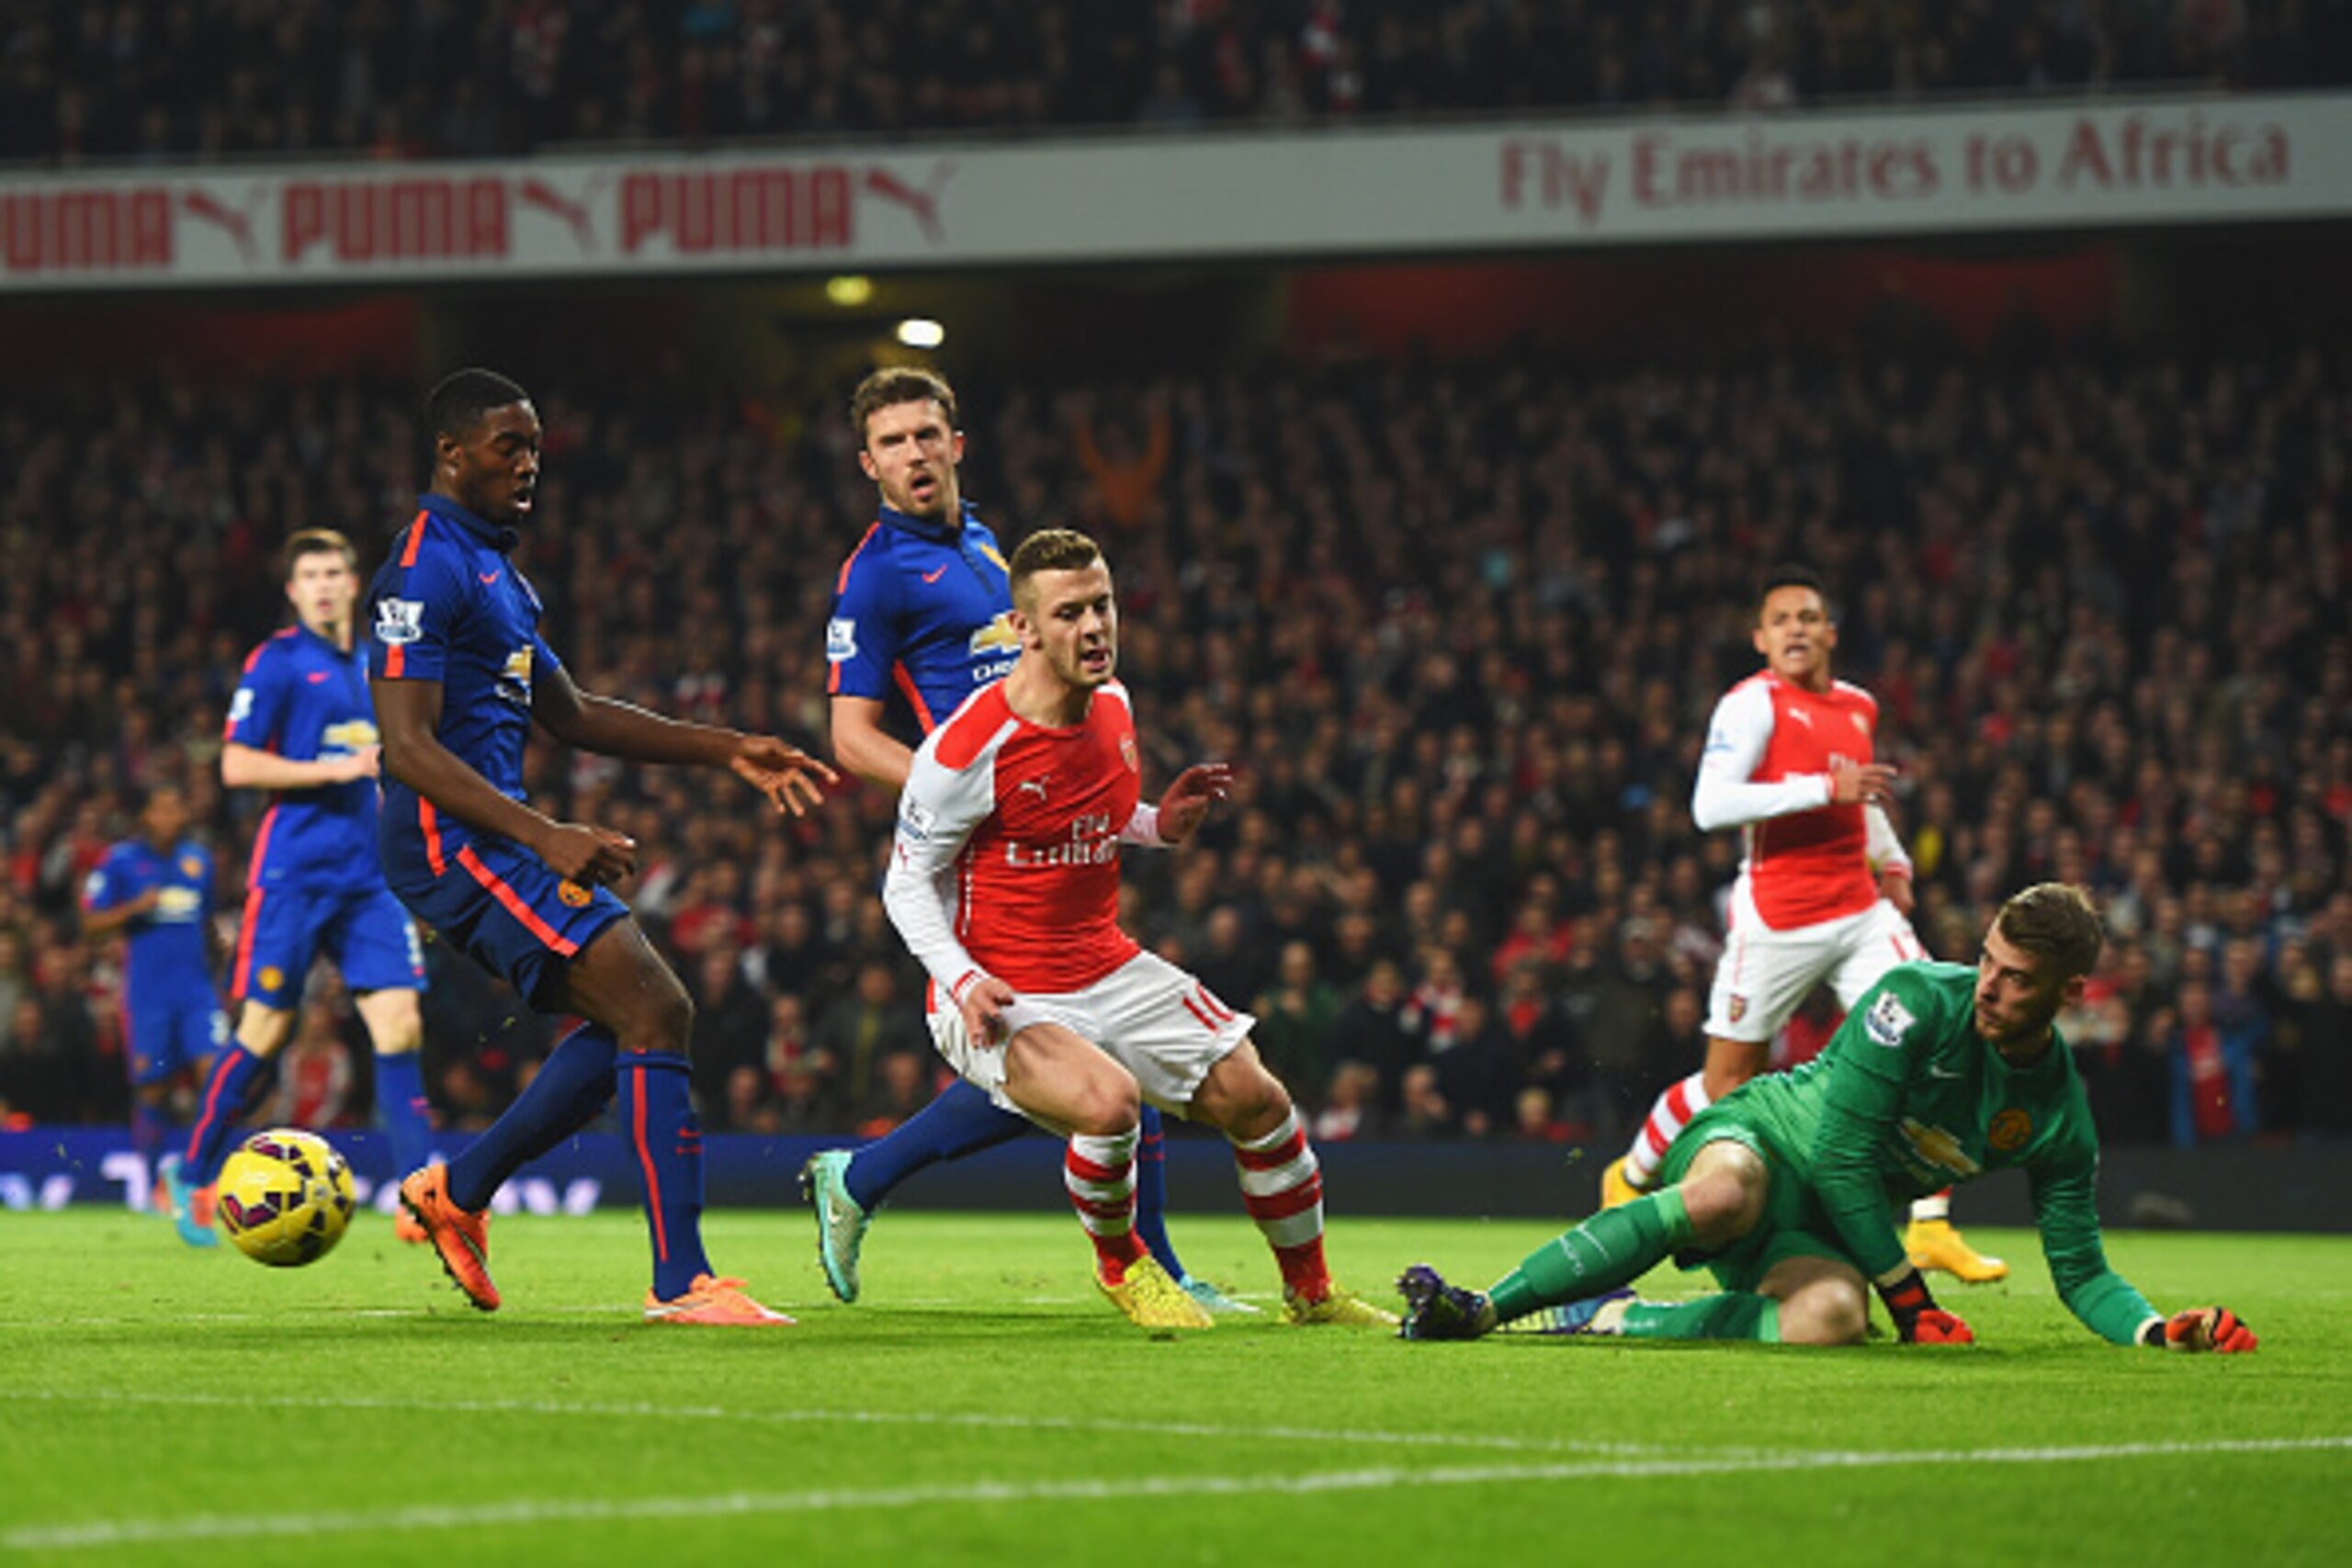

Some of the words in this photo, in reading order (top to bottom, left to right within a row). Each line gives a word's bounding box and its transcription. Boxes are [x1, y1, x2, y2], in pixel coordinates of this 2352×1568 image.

[0, 186, 173, 271] UMA
[282, 176, 512, 264] PUMA
[618, 165, 854, 254] PUMA
[1499, 132, 1610, 230] Fly
[1631, 126, 1940, 209] Emirates
[1964, 130, 2041, 197] to
[2056, 108, 2291, 191] Africa
